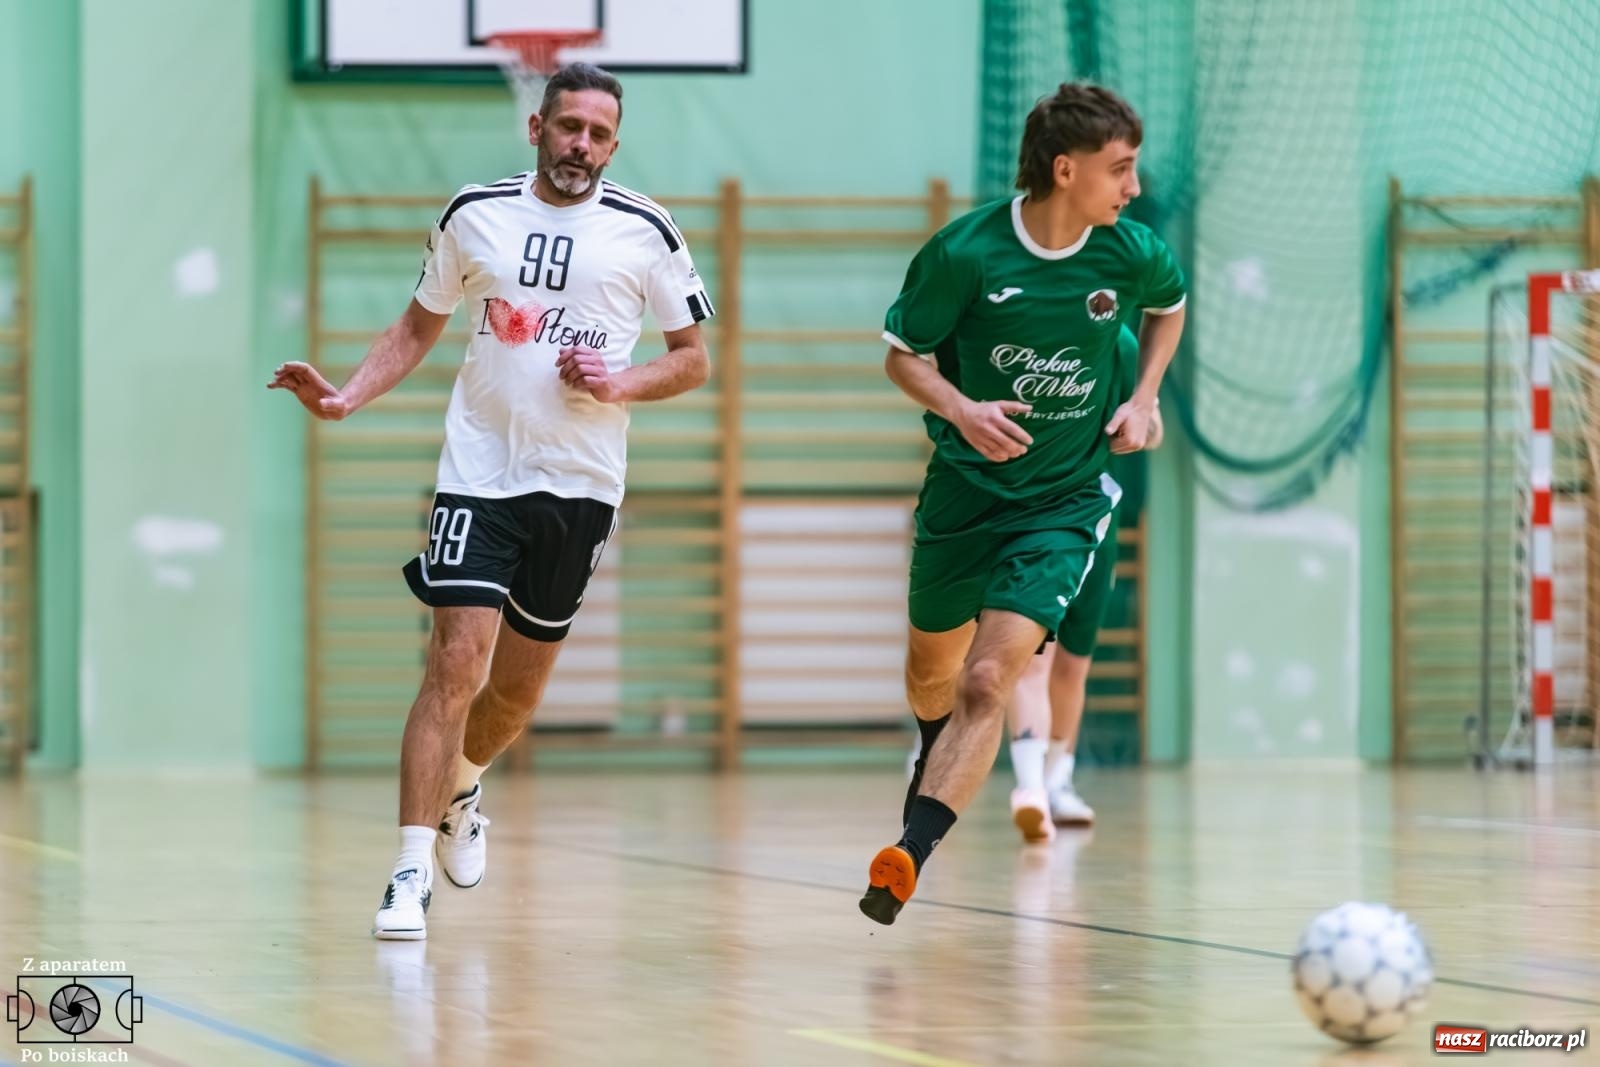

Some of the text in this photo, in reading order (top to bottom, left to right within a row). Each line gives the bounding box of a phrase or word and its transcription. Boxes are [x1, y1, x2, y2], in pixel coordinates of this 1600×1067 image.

[519, 233, 574, 291] 99
[989, 344, 1082, 374] Piękne
[1012, 367, 1097, 410] Włosy
[429, 506, 473, 566] 99
